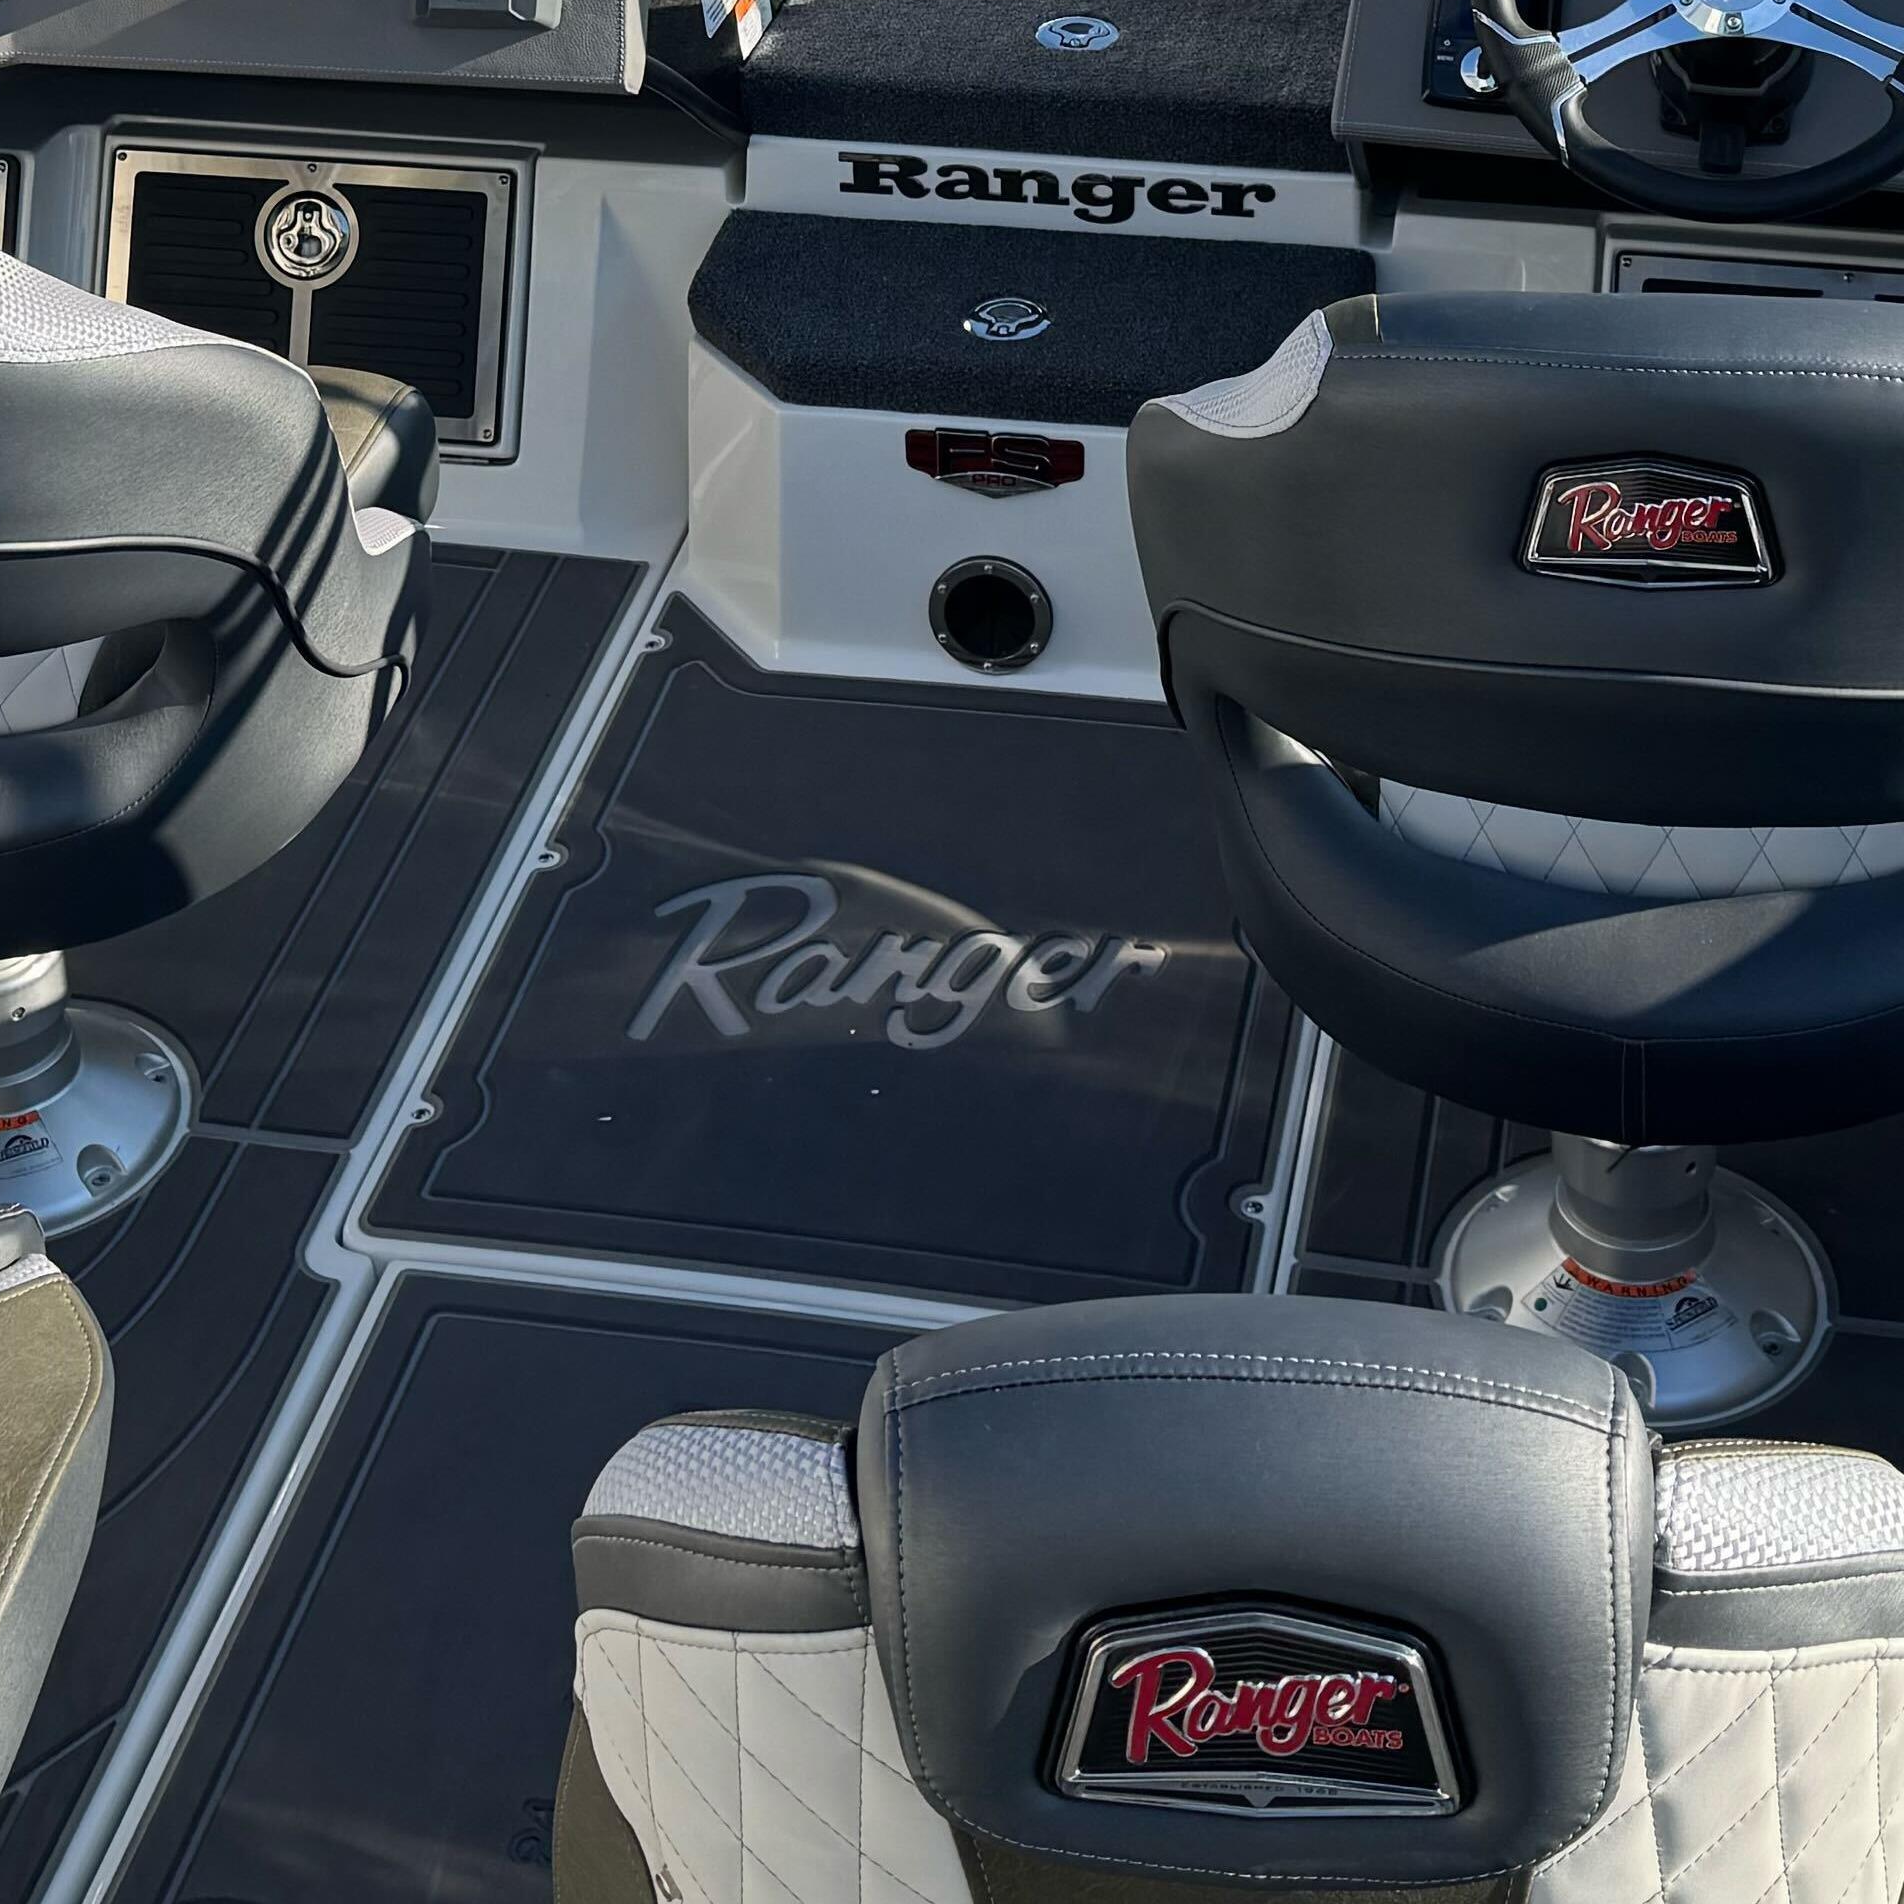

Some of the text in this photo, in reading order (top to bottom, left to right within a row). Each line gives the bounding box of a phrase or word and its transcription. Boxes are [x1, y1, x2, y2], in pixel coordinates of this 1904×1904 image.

[838, 151, 1276, 225] Ranger
[971, 473, 1016, 487] PRO
[1557, 481, 1732, 552] Ranger
[1680, 529, 1738, 544] BOATS
[626, 872, 1169, 1050] Ranger
[1587, 1274, 1688, 1297] WARNING
[1109, 1645, 1396, 1763] Ranger
[1312, 1726, 1403, 1750] BOATS
